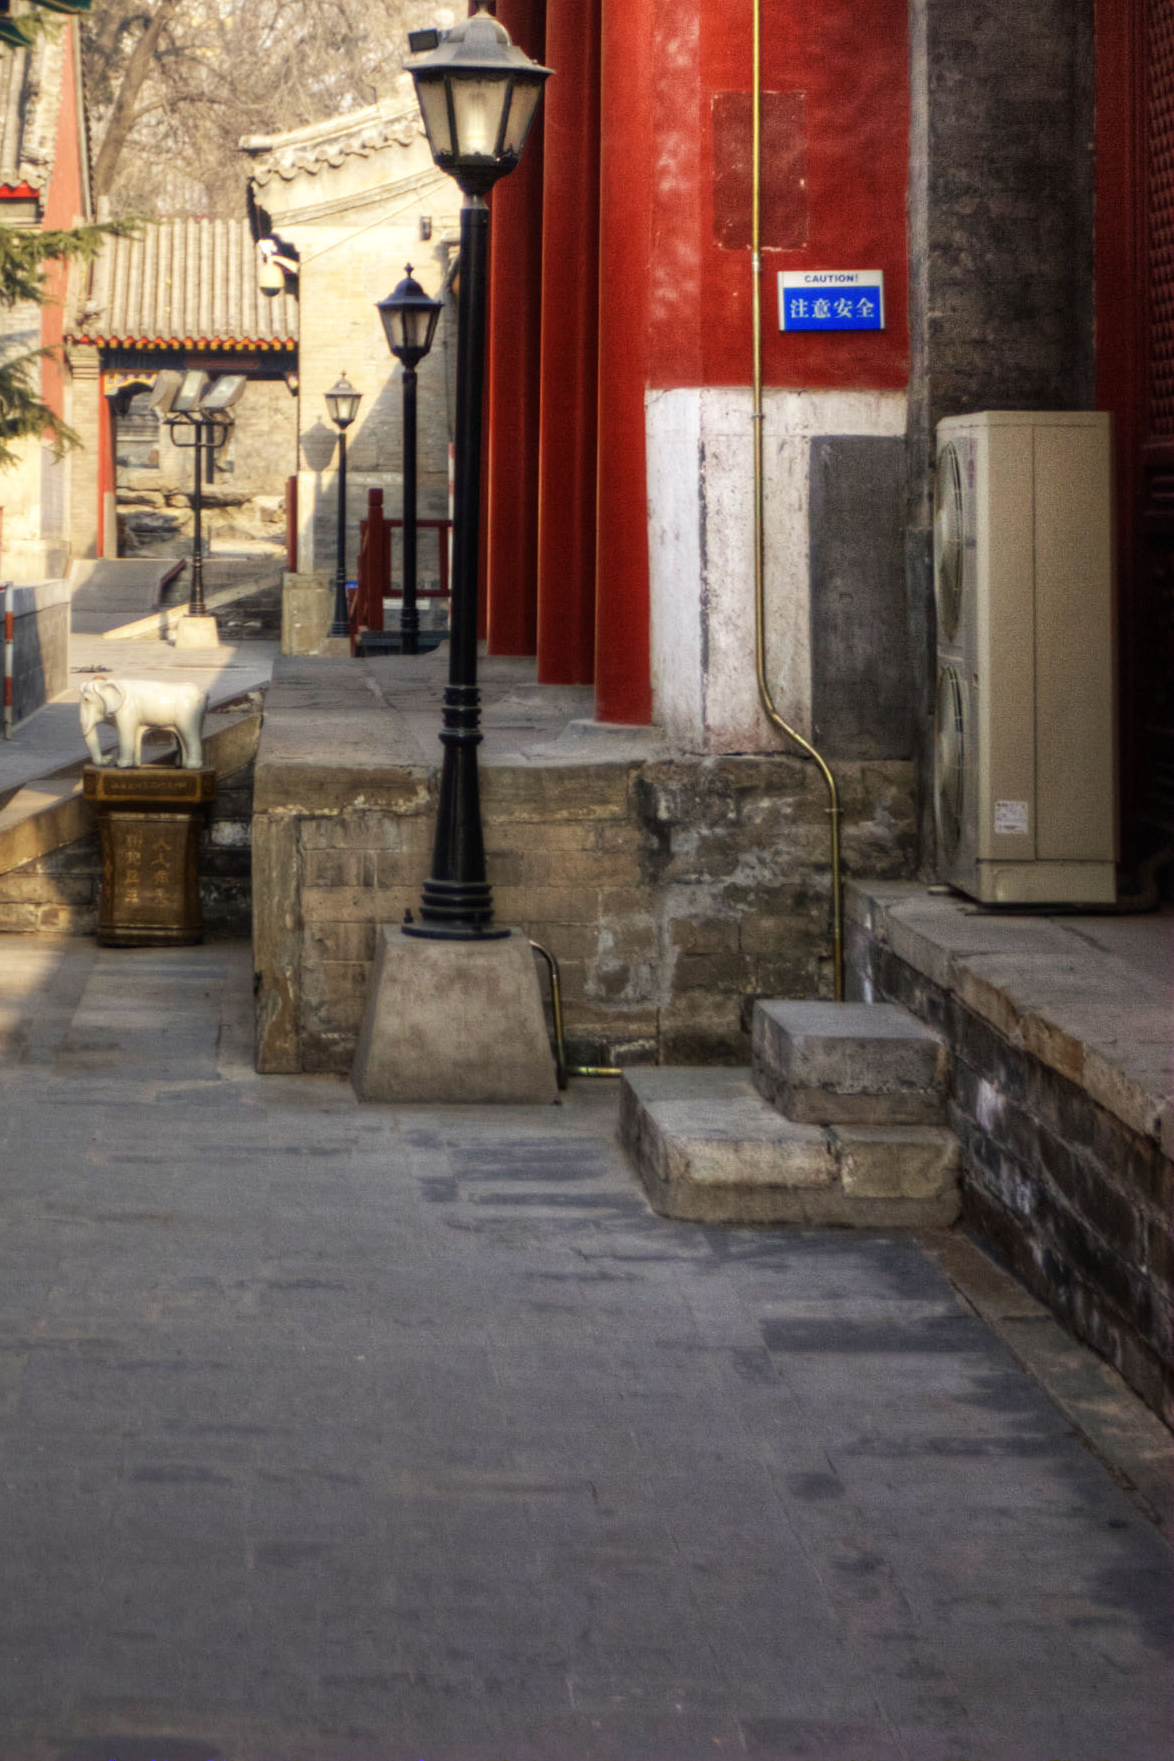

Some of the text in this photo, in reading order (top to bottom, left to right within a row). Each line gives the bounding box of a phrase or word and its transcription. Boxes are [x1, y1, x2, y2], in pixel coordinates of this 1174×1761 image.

[804, 274, 859, 283] CAUTION!
[790, 297, 874, 319] 注意安全
